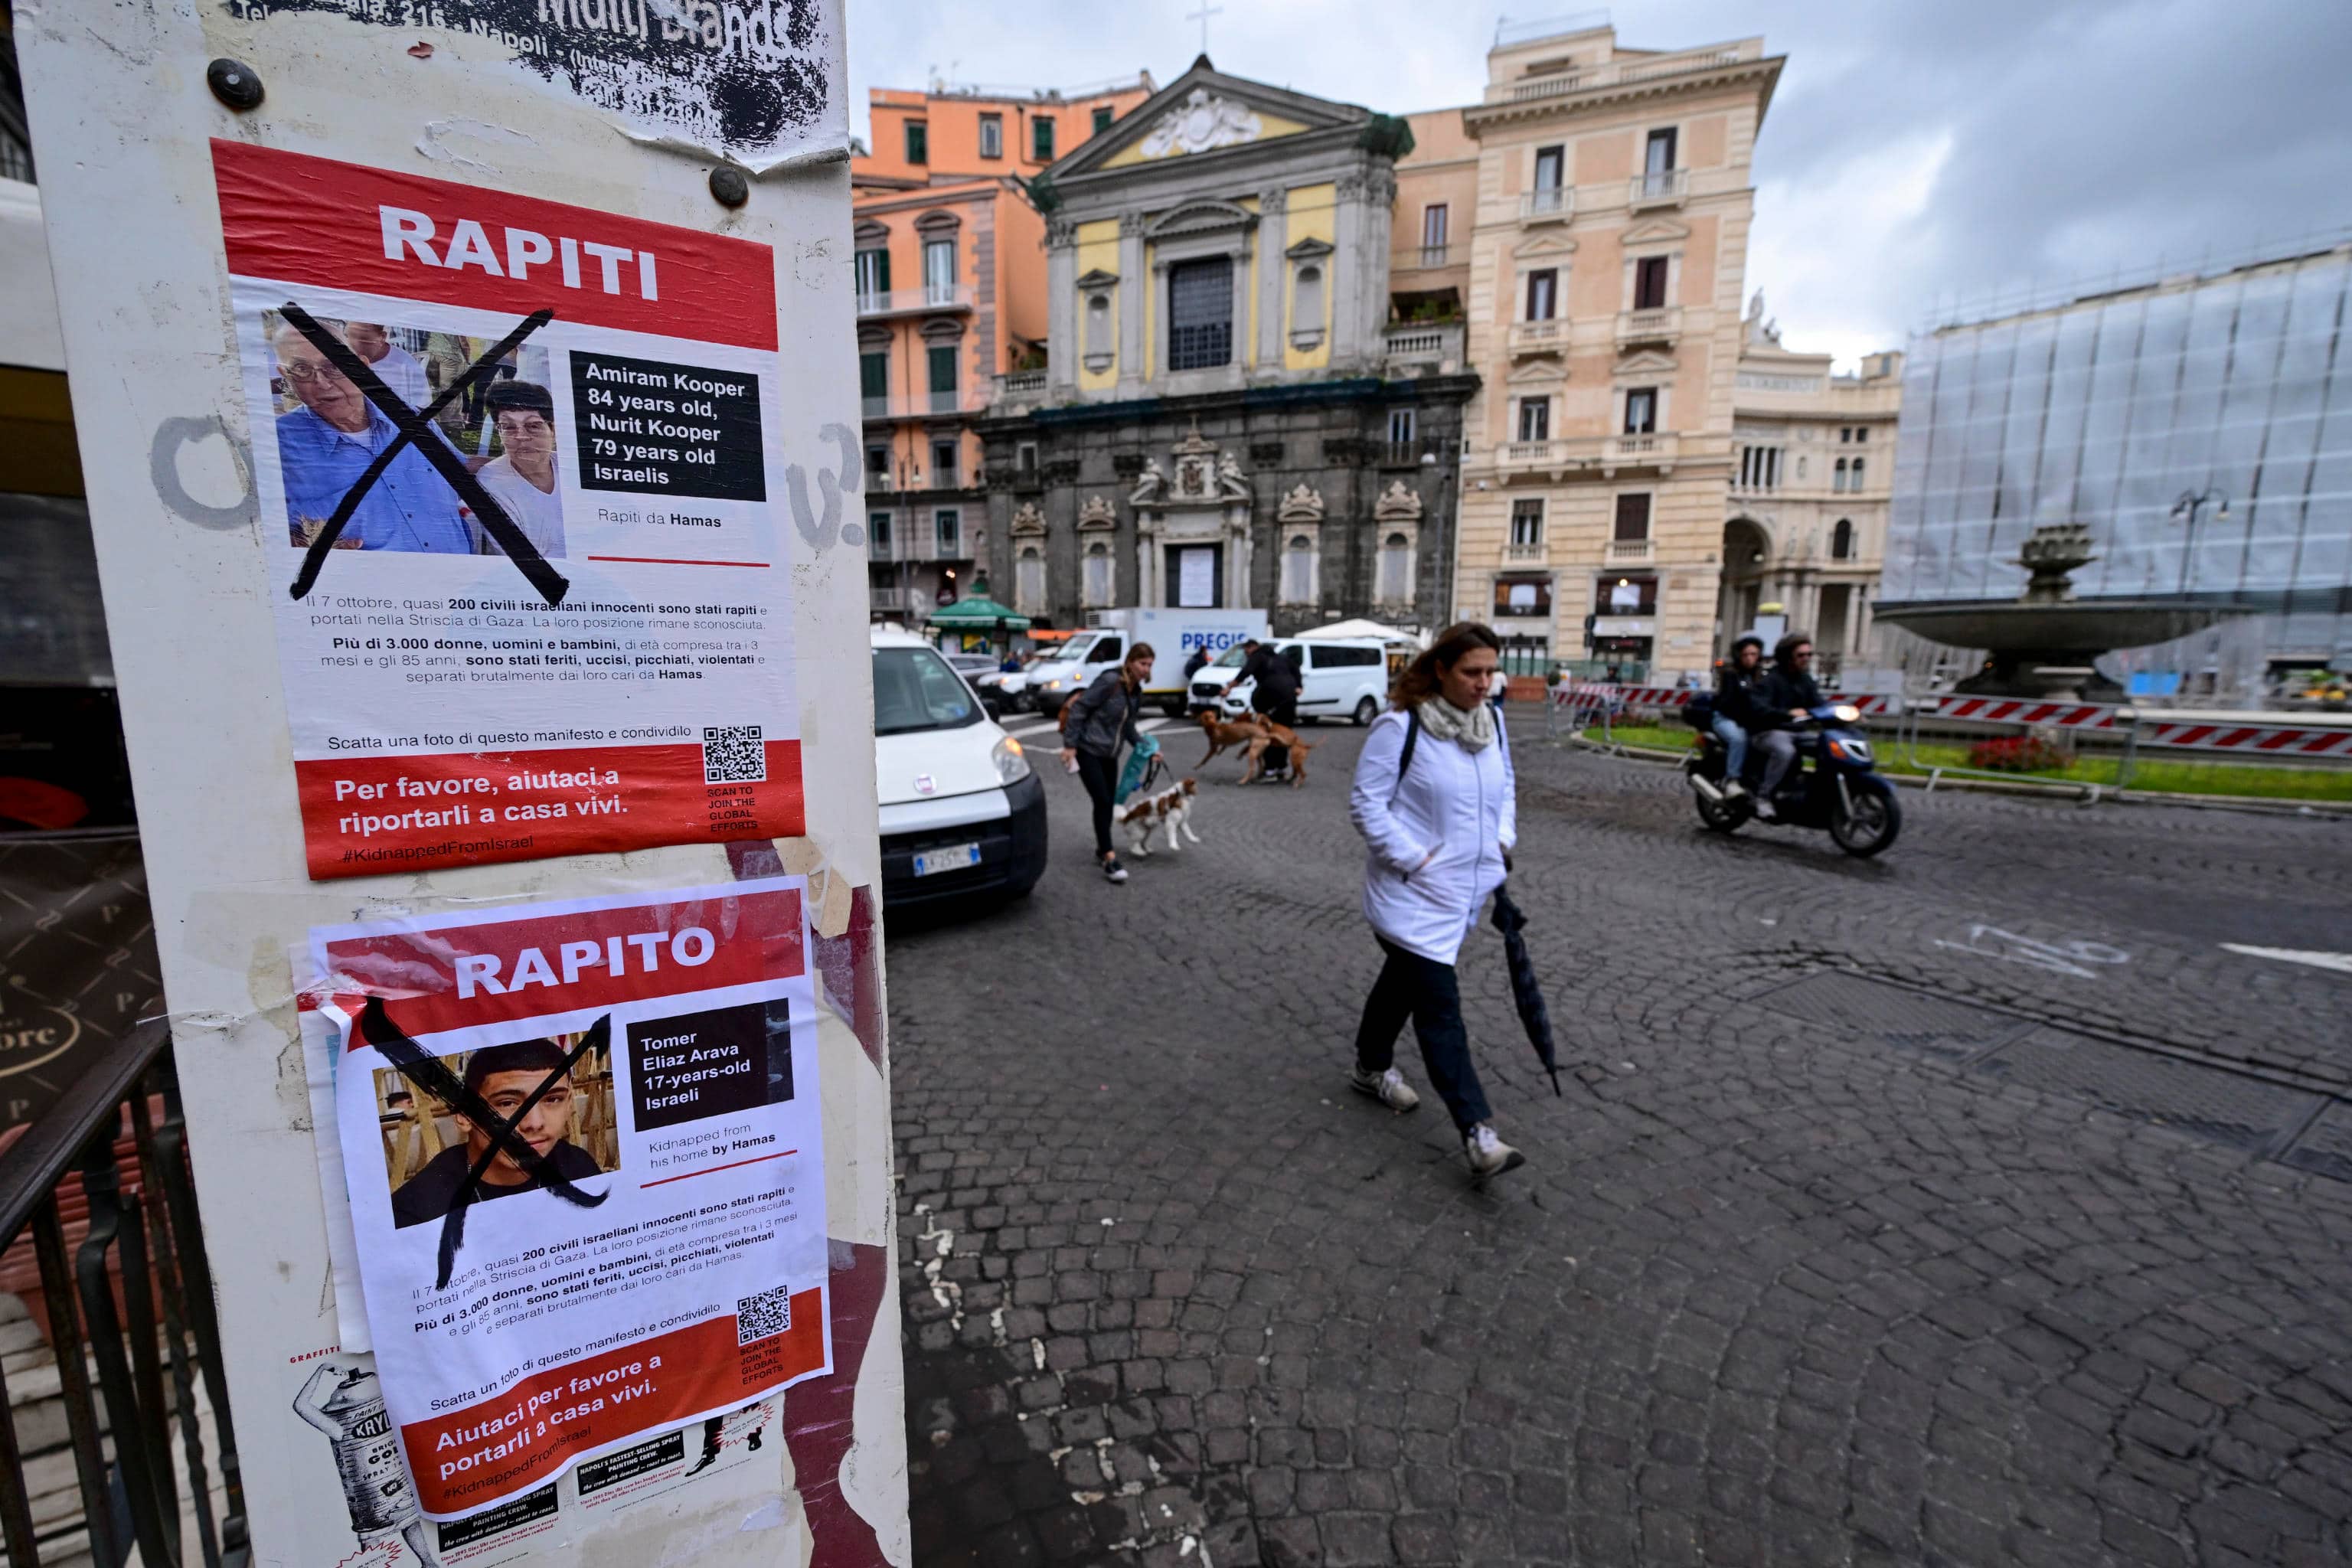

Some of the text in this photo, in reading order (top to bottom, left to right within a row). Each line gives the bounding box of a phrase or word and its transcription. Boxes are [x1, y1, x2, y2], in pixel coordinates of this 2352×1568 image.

[379, 204, 658, 302] RAPITI
[586, 363, 744, 397] Amiram Kooper
[588, 388, 717, 420] 84 years old,
[591, 413, 720, 443] Nurit Kooper
[592, 439, 715, 464] 79 years old
[595, 463, 669, 484] Israelis
[599, 508, 721, 527] Rapiti da Hamas
[322, 596, 330, 606] 7
[337, 597, 397, 609] ottobre,
[403, 600, 443, 611] quasi
[449, 599, 475, 609] 200
[481, 599, 515, 610] civili
[521, 600, 586, 612] israeliani
[592, 602, 654, 612] innocenti
[695, 605, 721, 614] stati
[726, 605, 756, 617] rapiti
[312, 614, 361, 626] portati
[368, 614, 404, 625] nella
[410, 614, 464, 626] Striscia
[469, 616, 481, 626] di
[533, 616, 550, 627] La
[555, 617, 579, 627] loro
[583, 617, 643, 629] posizione
[649, 619, 689, 629] rimane
[694, 619, 765, 629] sconosciuta.
[334, 638, 359, 648] Più
[366, 639, 380, 648] di
[387, 639, 428, 648] 3.000
[435, 639, 487, 651] donne,
[493, 639, 542, 649] uomini
[560, 639, 620, 651] bambini,
[626, 640, 635, 649] di
[640, 640, 659, 649] età
[663, 642, 723, 652] compresa
[751, 641, 758, 649] 3
[322, 657, 358, 666] mesi
[380, 655, 396, 668] gli
[402, 655, 420, 665] 85
[509, 655, 539, 665] stati
[545, 655, 580, 666] feriti,
[586, 655, 630, 665] uccisi,
[635, 655, 694, 667] picchiati,
[698, 655, 753, 664] violentati
[407, 671, 466, 684] separati
[472, 671, 554, 681] brutalmente
[559, 671, 578, 680] dai
[583, 670, 606, 680] loro
[612, 670, 634, 680] cari
[639, 671, 654, 679] da
[328, 737, 382, 750] Scatta
[389, 737, 419, 746] una
[424, 734, 453, 745] foto
[459, 733, 472, 744] di
[478, 732, 528, 746] questo
[534, 729, 603, 741] manifesto
[622, 726, 691, 738] condividilo
[335, 769, 619, 801] Per favore, aiutaci a
[707, 786, 753, 797] SCAN TO
[708, 798, 755, 808] JOIN THE
[710, 809, 753, 820] GLOBAL
[340, 795, 627, 837] riportarli a casa vivi.
[710, 821, 758, 832] EFFORTS
[342, 836, 534, 864] #KidnappedFromIsrael
[455, 927, 716, 1000] RAPITO
[641, 1034, 697, 1050] Tomer
[643, 1046, 738, 1070] Eliaz Arava
[645, 1060, 750, 1089] 17-years-old
[646, 1088, 698, 1110] Israeli
[649, 1125, 750, 1153] Kidnapped from
[651, 1135, 775, 1168] his home by Hamas
[461, 1230, 773, 1334] gli 85 anni, sono stati feriti, uccisi, picchiati, violentati
[289, 1345, 341, 1364] GRAFFITI
[431, 1391, 476, 1410] Scatta
[481, 1383, 497, 1394] un
[501, 1368, 518, 1385] foto
[523, 1360, 533, 1370] di
[538, 1348, 581, 1366] questo
[586, 1328, 645, 1351] manifesto
[660, 1305, 720, 1328] condividilo
[740, 1337, 779, 1356] SCAN TO
[741, 1347, 782, 1365] JOIN THE
[742, 1357, 779, 1375] GLOBAL
[743, 1364, 782, 1384] EFFORTS
[436, 1354, 662, 1451] Aiutaci per favore a
[440, 1383, 656, 1481] portarli a casa vivi.
[443, 1426, 592, 1498] #KidnappedFromIsrael
